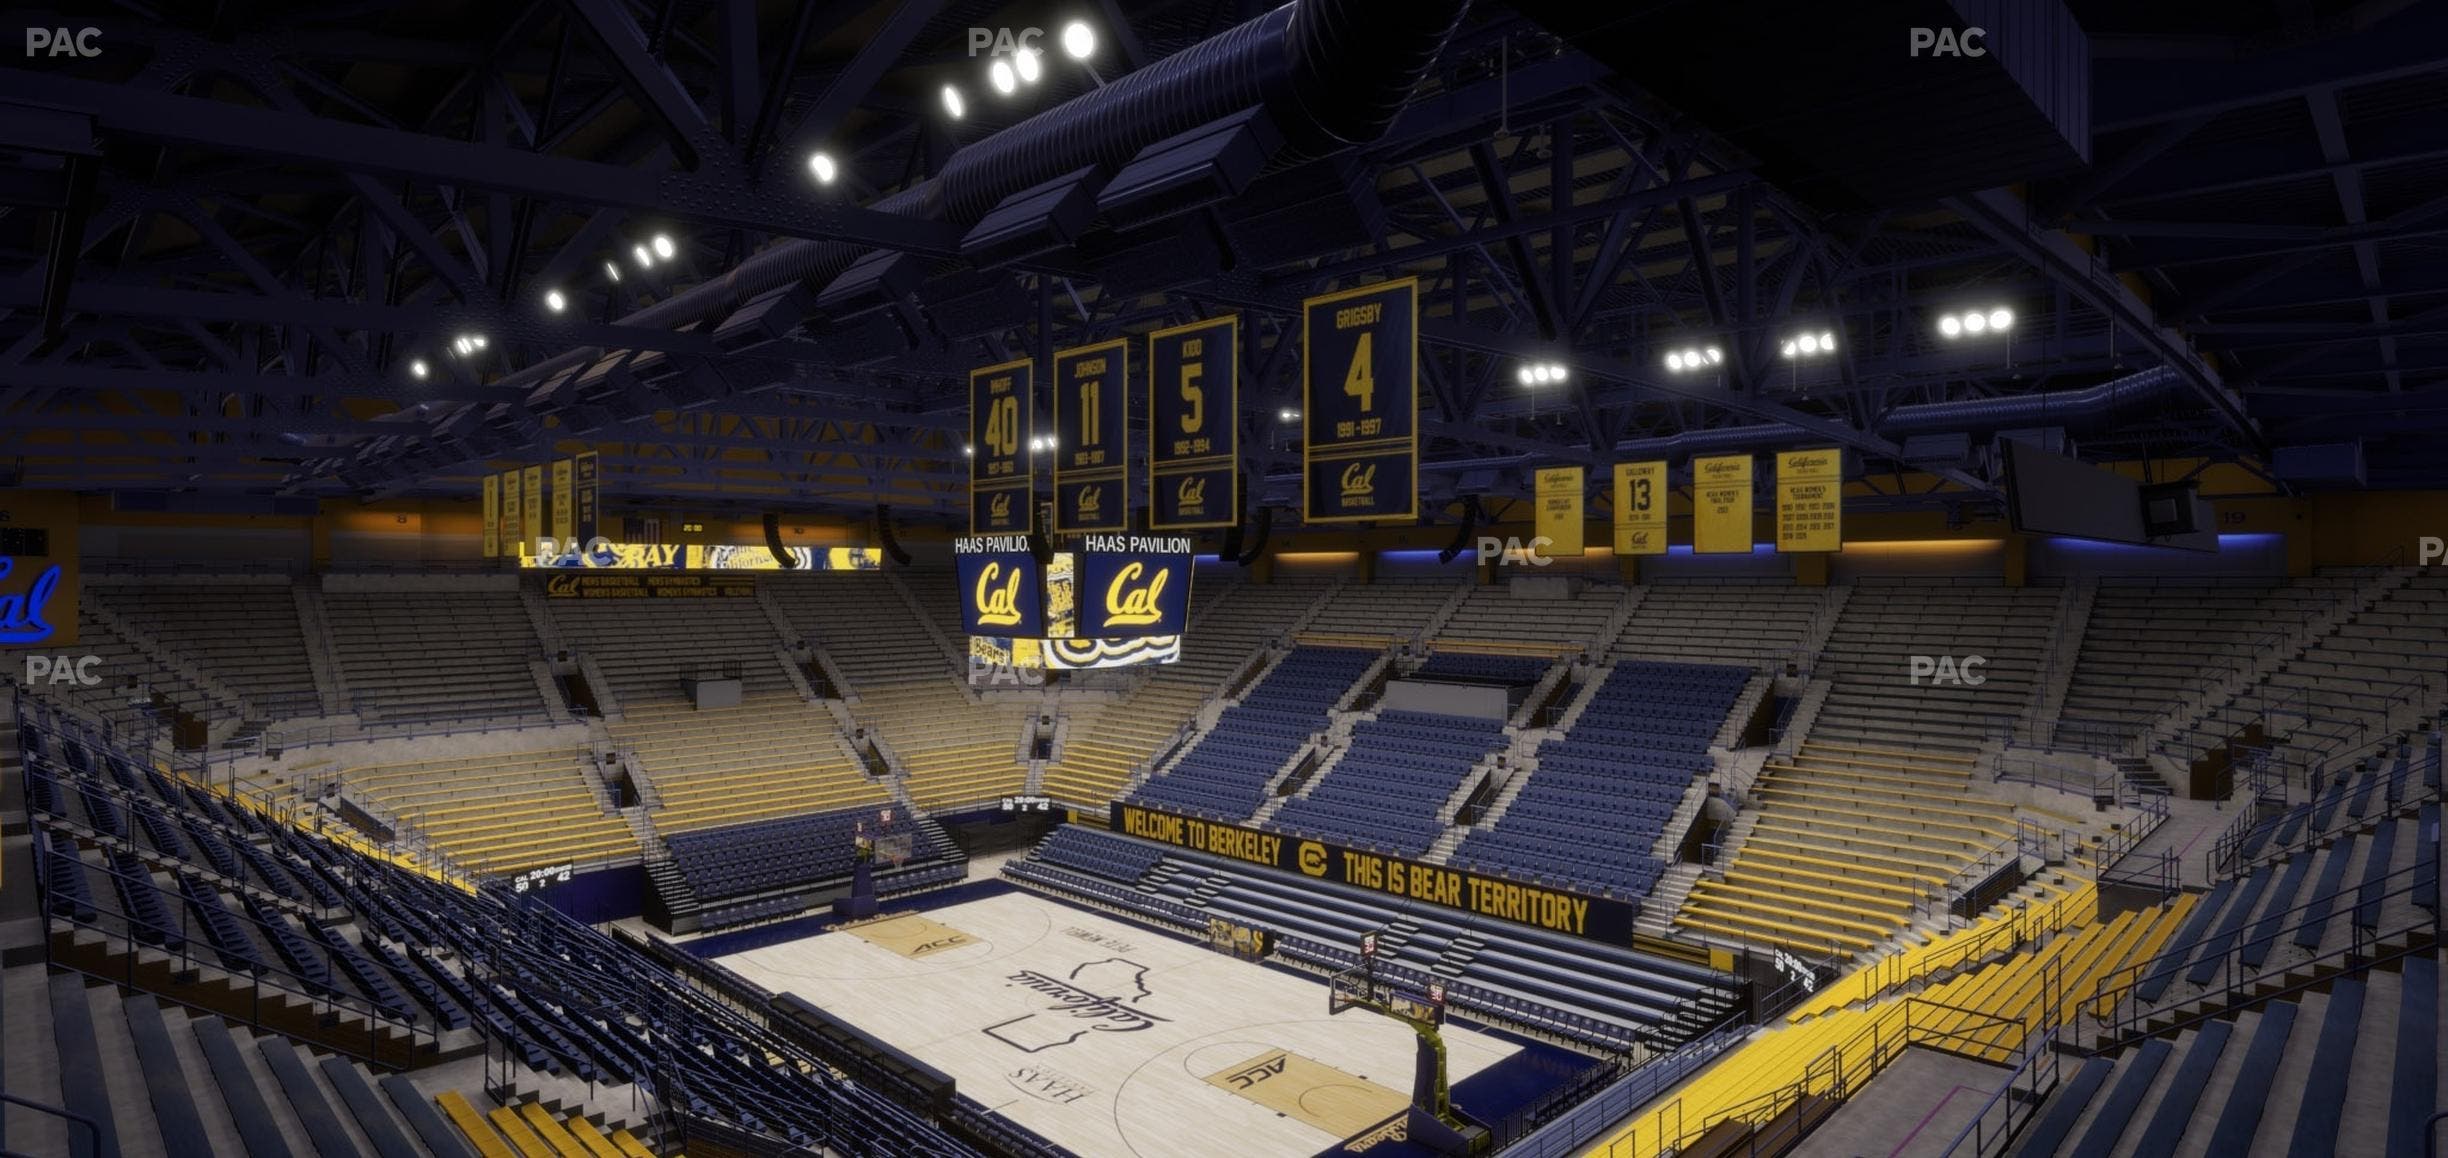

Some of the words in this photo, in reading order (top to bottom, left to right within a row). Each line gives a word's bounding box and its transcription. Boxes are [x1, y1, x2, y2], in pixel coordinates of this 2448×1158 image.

[1336, 303, 1383, 329] GRIGSBY
[1343, 331, 1374, 412] 4
[1080, 380, 1100, 447] 11
[1181, 362, 1203, 434] 5
[984, 396, 1018, 457] 40
[1178, 476, 1206, 506] Cal
[1340, 462, 1376, 496] Cal
[1630, 479, 1651, 511] 13
[990, 492, 1010, 519] Cal
[1077, 484, 1102, 513] Cal
[955, 537, 983, 554] HAAS
[986, 535, 1031, 552] PAVILIO
[1086, 535, 1126, 552] HAAS
[1129, 536, 1190, 554] PAVILION
[0, 556, 62, 645] al
[547, 573, 580, 598] Cal
[976, 562, 1022, 626] Cal
[1103, 561, 1169, 627] Cal
[1123, 806, 1185, 846] WELCOME
[1186, 819, 1206, 848] TO
[1208, 823, 1282, 867] BERKELEY
[515, 875, 528, 883] CAL
[530, 867, 555, 880] 20:00
[539, 879, 546, 888] 2
[1343, 851, 1383, 890] THIS
[1386, 859, 1406, 895] IS
[1409, 865, 1462, 908] BEAR
[1467, 876, 1589, 936] TERRITORY
[911, 935, 967, 953] ACC
[1006, 971, 1168, 1032] California
[1008, 1067, 1084, 1104] HAAS
[1226, 1054, 1287, 1090] ACC
